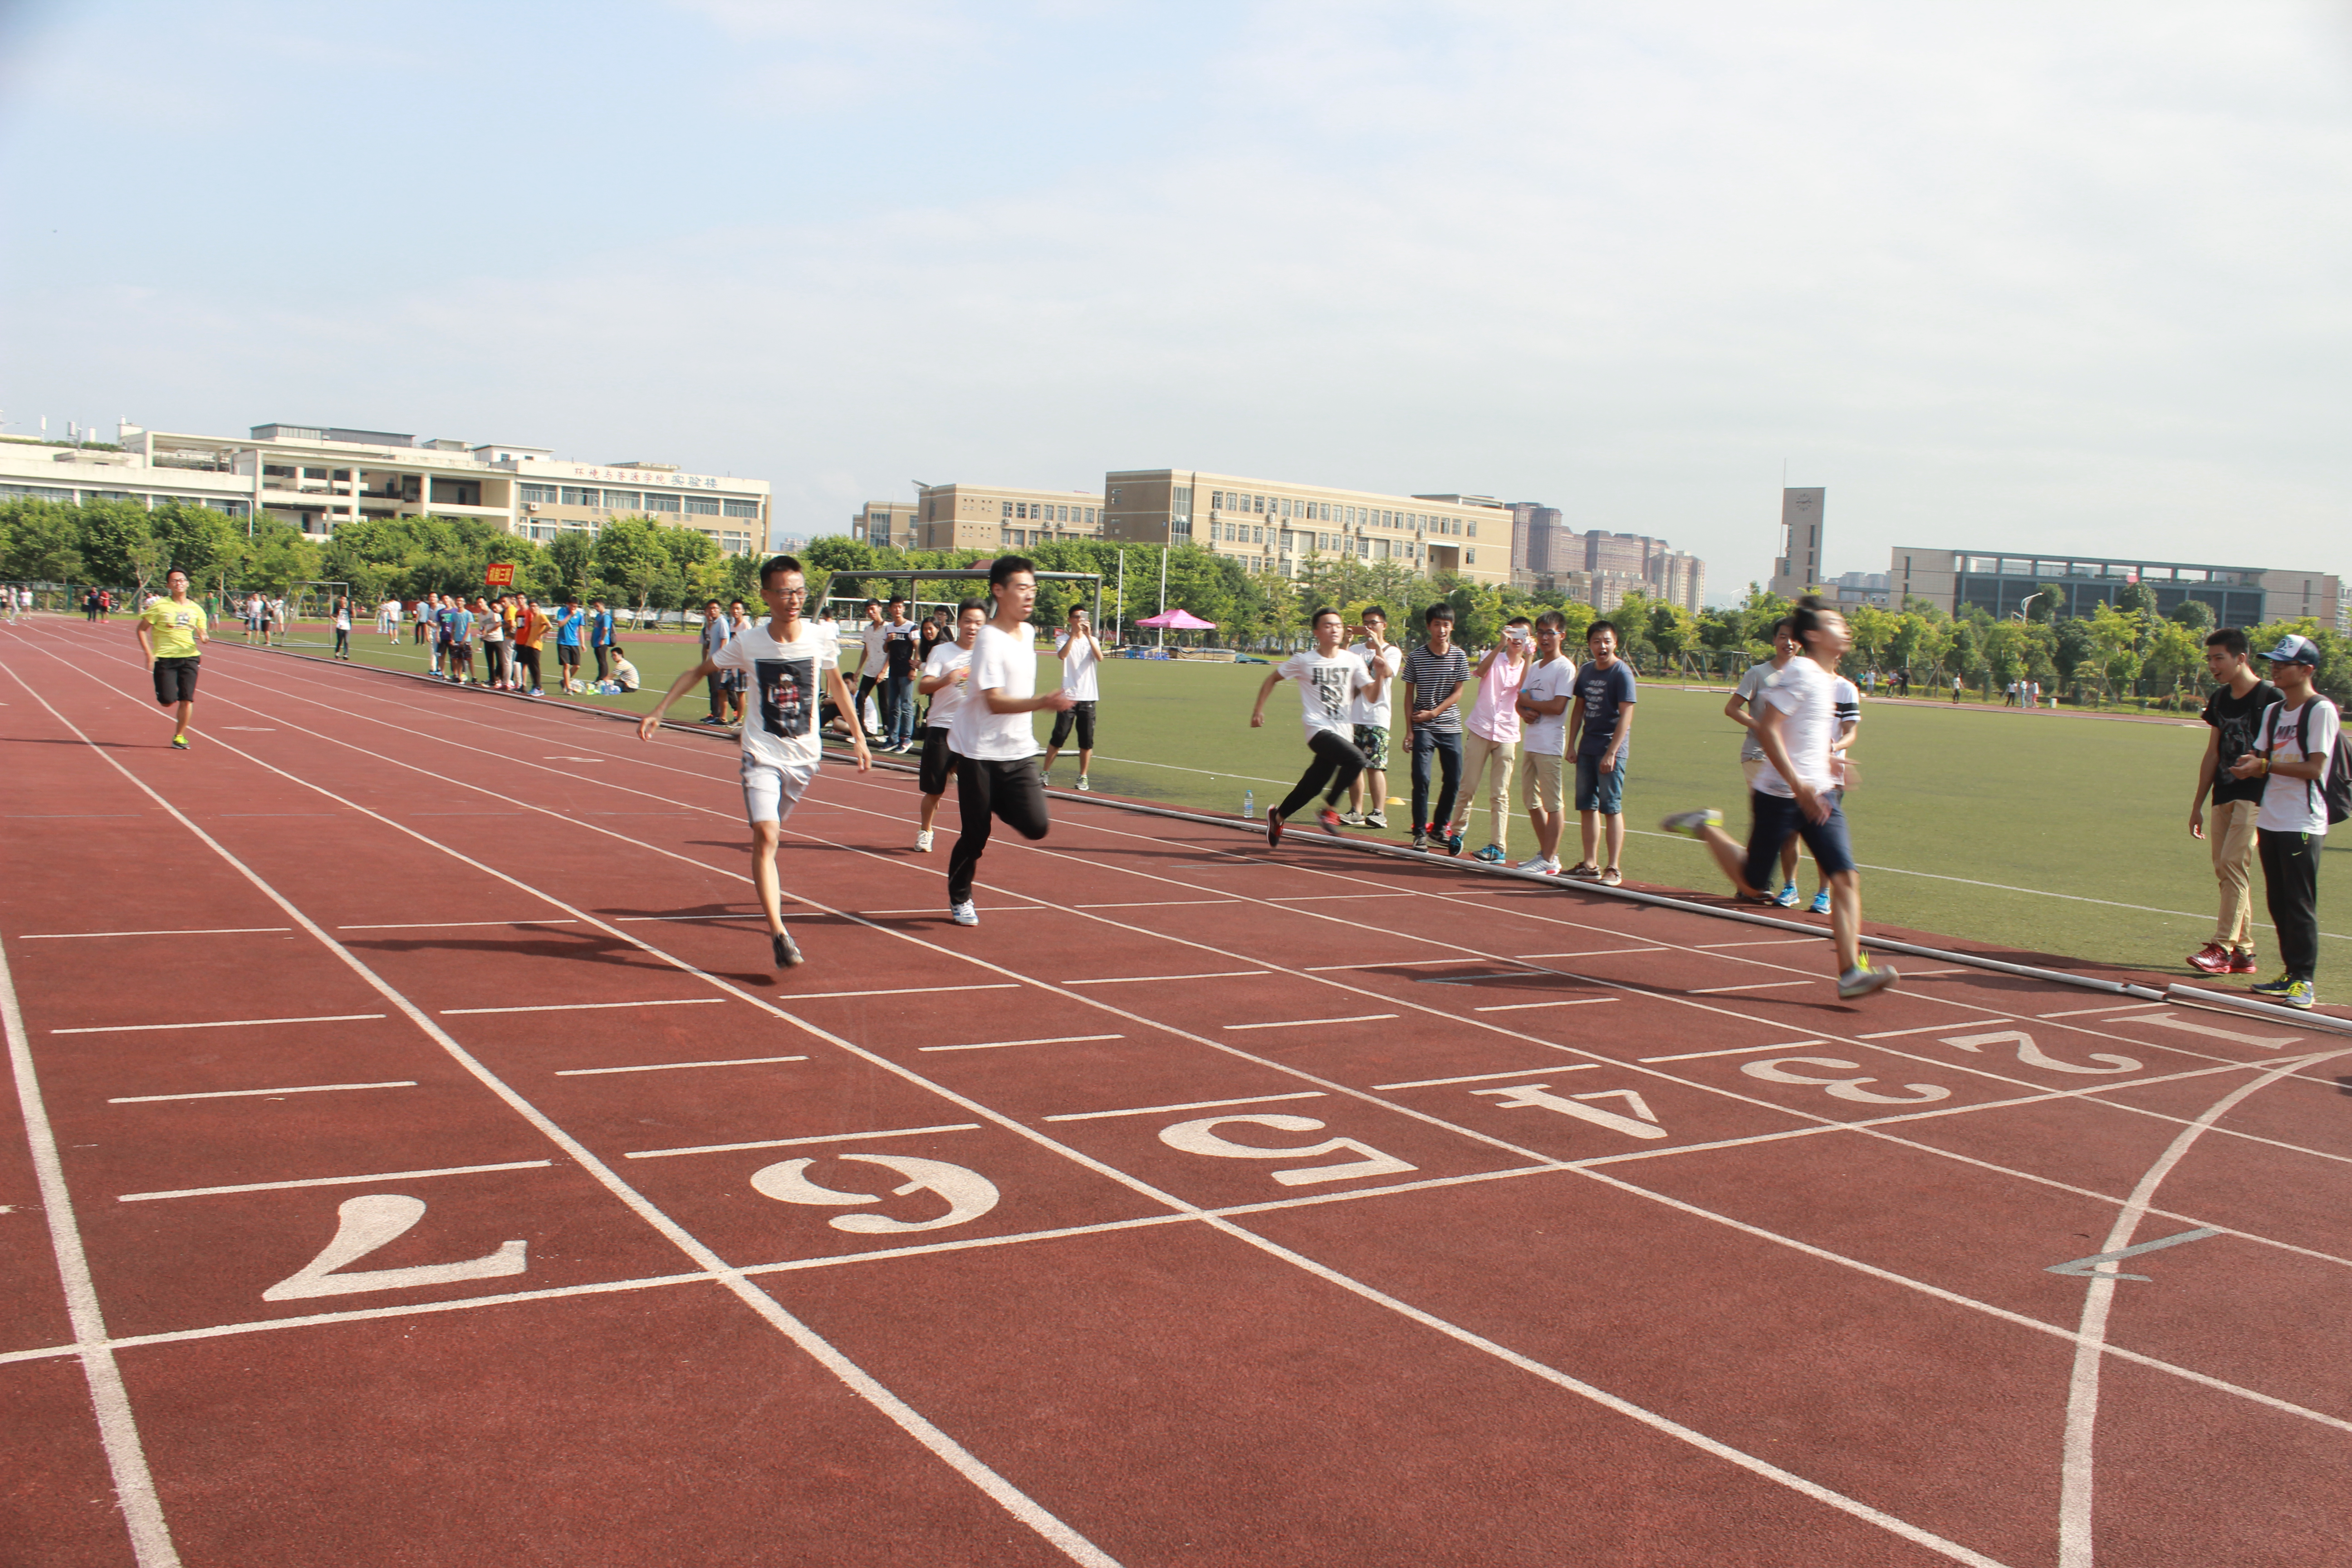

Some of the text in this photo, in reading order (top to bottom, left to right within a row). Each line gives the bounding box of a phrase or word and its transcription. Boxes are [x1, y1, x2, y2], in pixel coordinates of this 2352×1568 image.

[671, 475, 718, 489] 实验楼
[1312, 667, 1349, 685] JUST
[1320, 686, 1343, 703] DO
[1937, 1030, 2142, 1073] 2
[2101, 1013, 2304, 1049] 1
[1740, 1057, 1950, 1104] 3
[1469, 1084, 1667, 1139] 4
[1158, 1114, 1419, 1186] 5
[750, 1154, 1000, 1234] 6
[261, 1195, 527, 1302] 7
